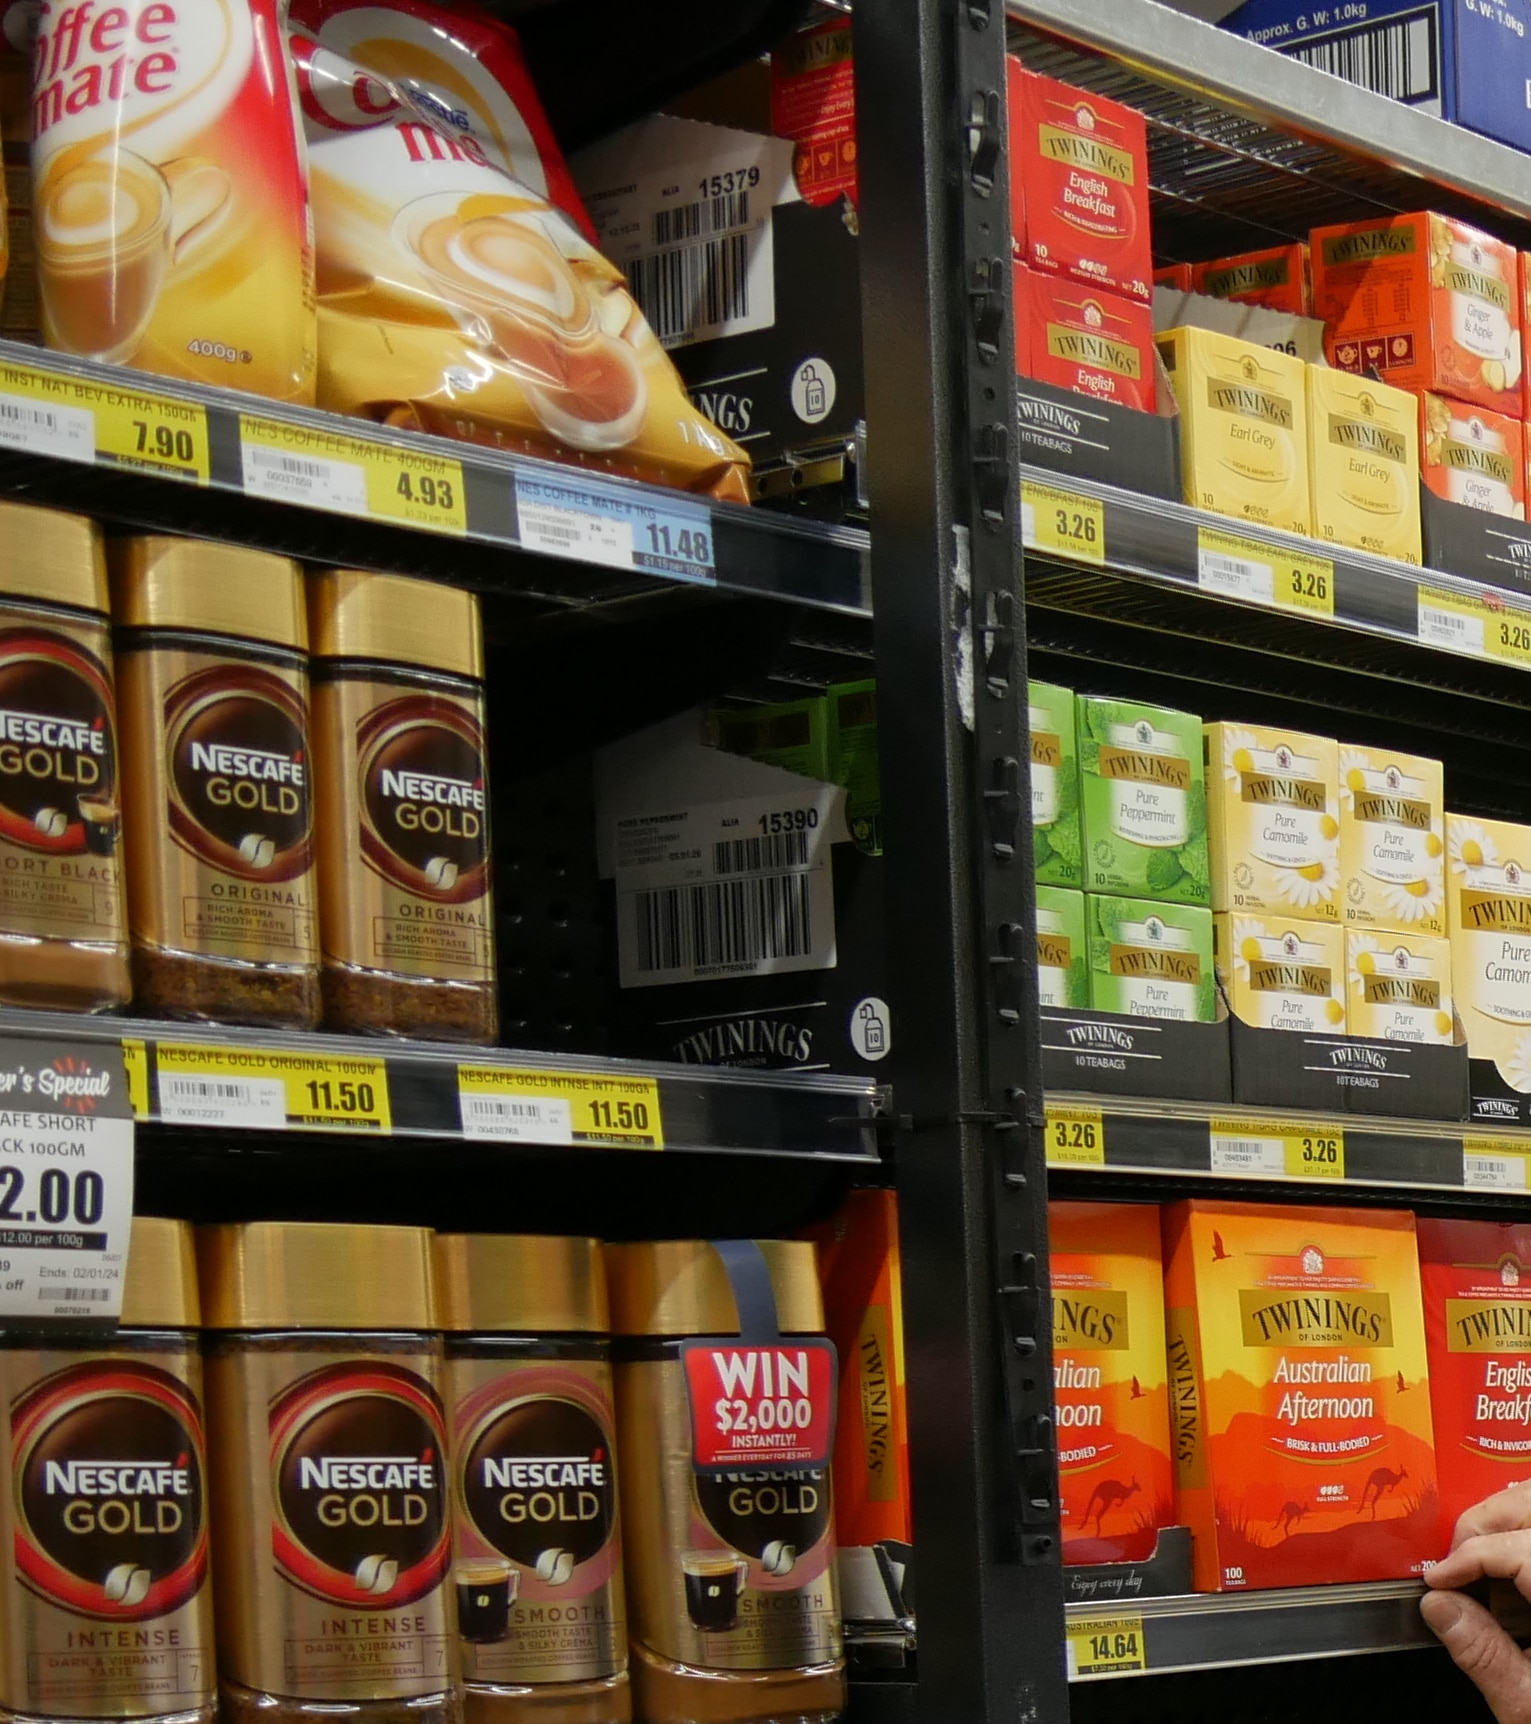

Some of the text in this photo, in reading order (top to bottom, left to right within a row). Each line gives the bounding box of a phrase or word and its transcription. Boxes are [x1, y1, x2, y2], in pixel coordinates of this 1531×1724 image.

[1246, 19, 1292, 43] Approx.
[1333, 1, 1367, 22] 1.0kg
[698, 165, 761, 198] 15379
[131, 420, 195, 463] 7.90
[396, 470, 454, 510] 4.93
[1055, 509, 1096, 542] 3.26
[645, 522, 711, 564] 11.48
[1500, 622, 1530, 650] 3.26
[205, 775, 301, 817] GOLD
[757, 808, 820, 834] 15390
[210, 881, 307, 908] ORIGINAL
[1501, 943, 1531, 963] Pure
[304, 1081, 375, 1116] 11.50
[1055, 1122, 1095, 1149] 3.26
[1253, 1298, 1382, 1342] TWININGS
[1299, 1333, 1343, 1341] OF LONDON
[712, 1350, 811, 1397] WIN
[1273, 1356, 1371, 1384] Australian
[714, 1398, 814, 1434] $2,000
[1277, 1393, 1374, 1426] Afternoon
[731, 1432, 799, 1450] INSTANTLY!
[1287, 1438, 1309, 1450] BRISK
[1310, 1440, 1317, 1450] &
[62, 1498, 184, 1536] GOLD
[66, 1628, 181, 1649] INTENSE
[1089, 1632, 1138, 1660] 14.64
